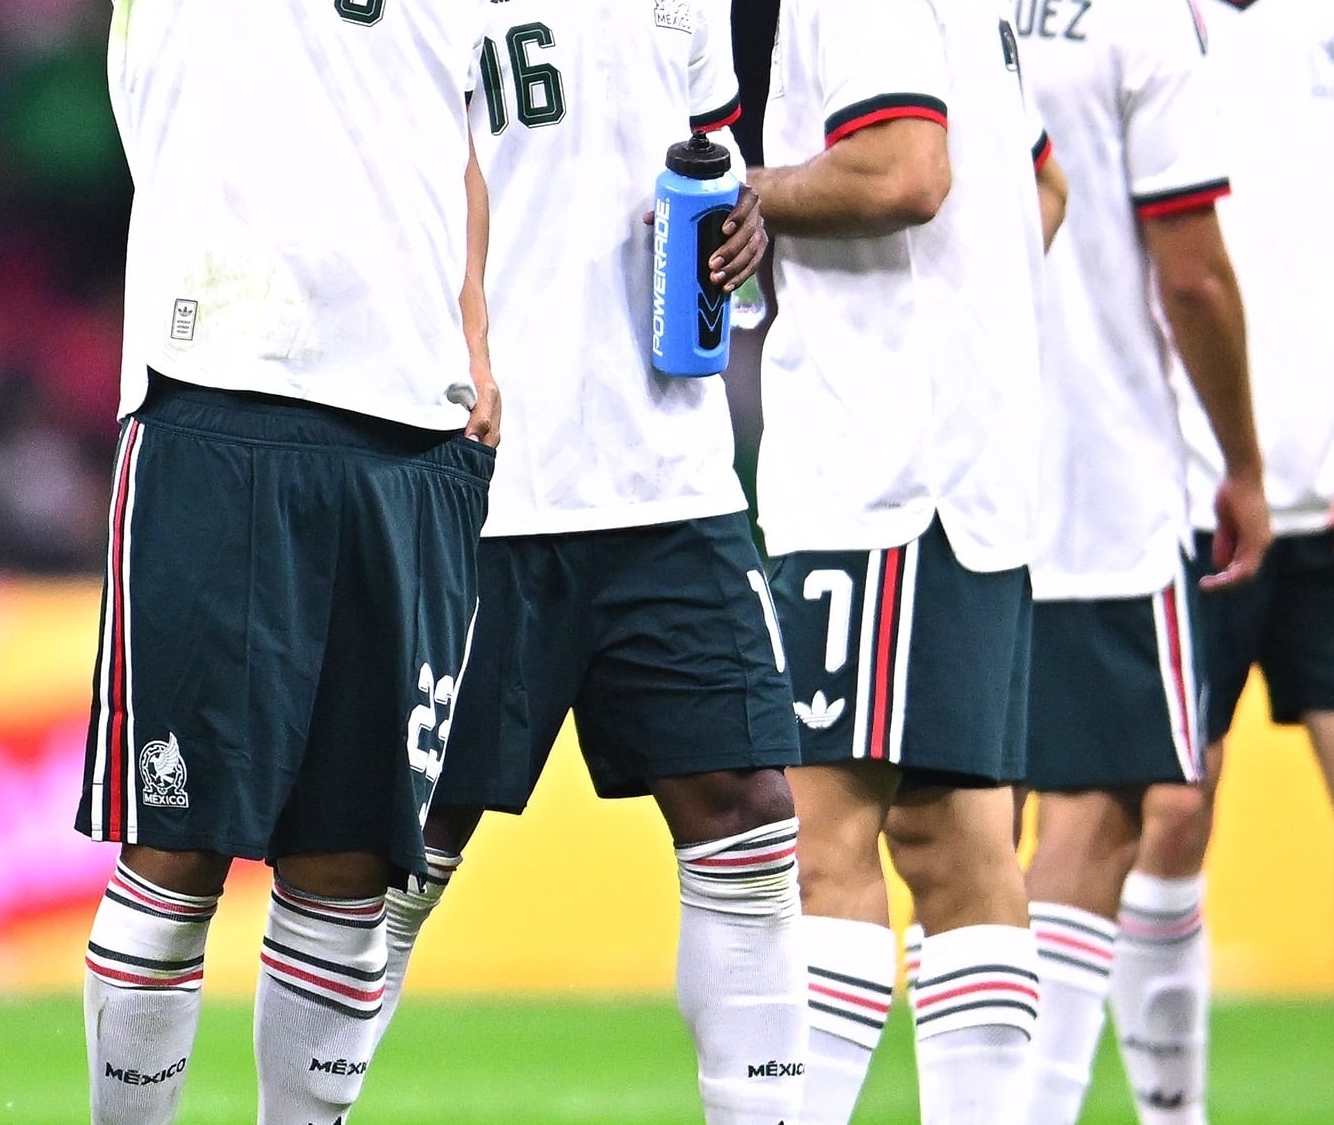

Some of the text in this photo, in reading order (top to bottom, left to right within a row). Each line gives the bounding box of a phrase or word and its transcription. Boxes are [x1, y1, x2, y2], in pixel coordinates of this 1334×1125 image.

[480, 21, 566, 136] 16
[652, 197, 671, 358] POWERADE
[803, 569, 853, 673] 7
[144, 792, 186, 805] MÉXICO
[105, 1057, 186, 1085] MÉXICO
[747, 1060, 805, 1078] MÉXIC
